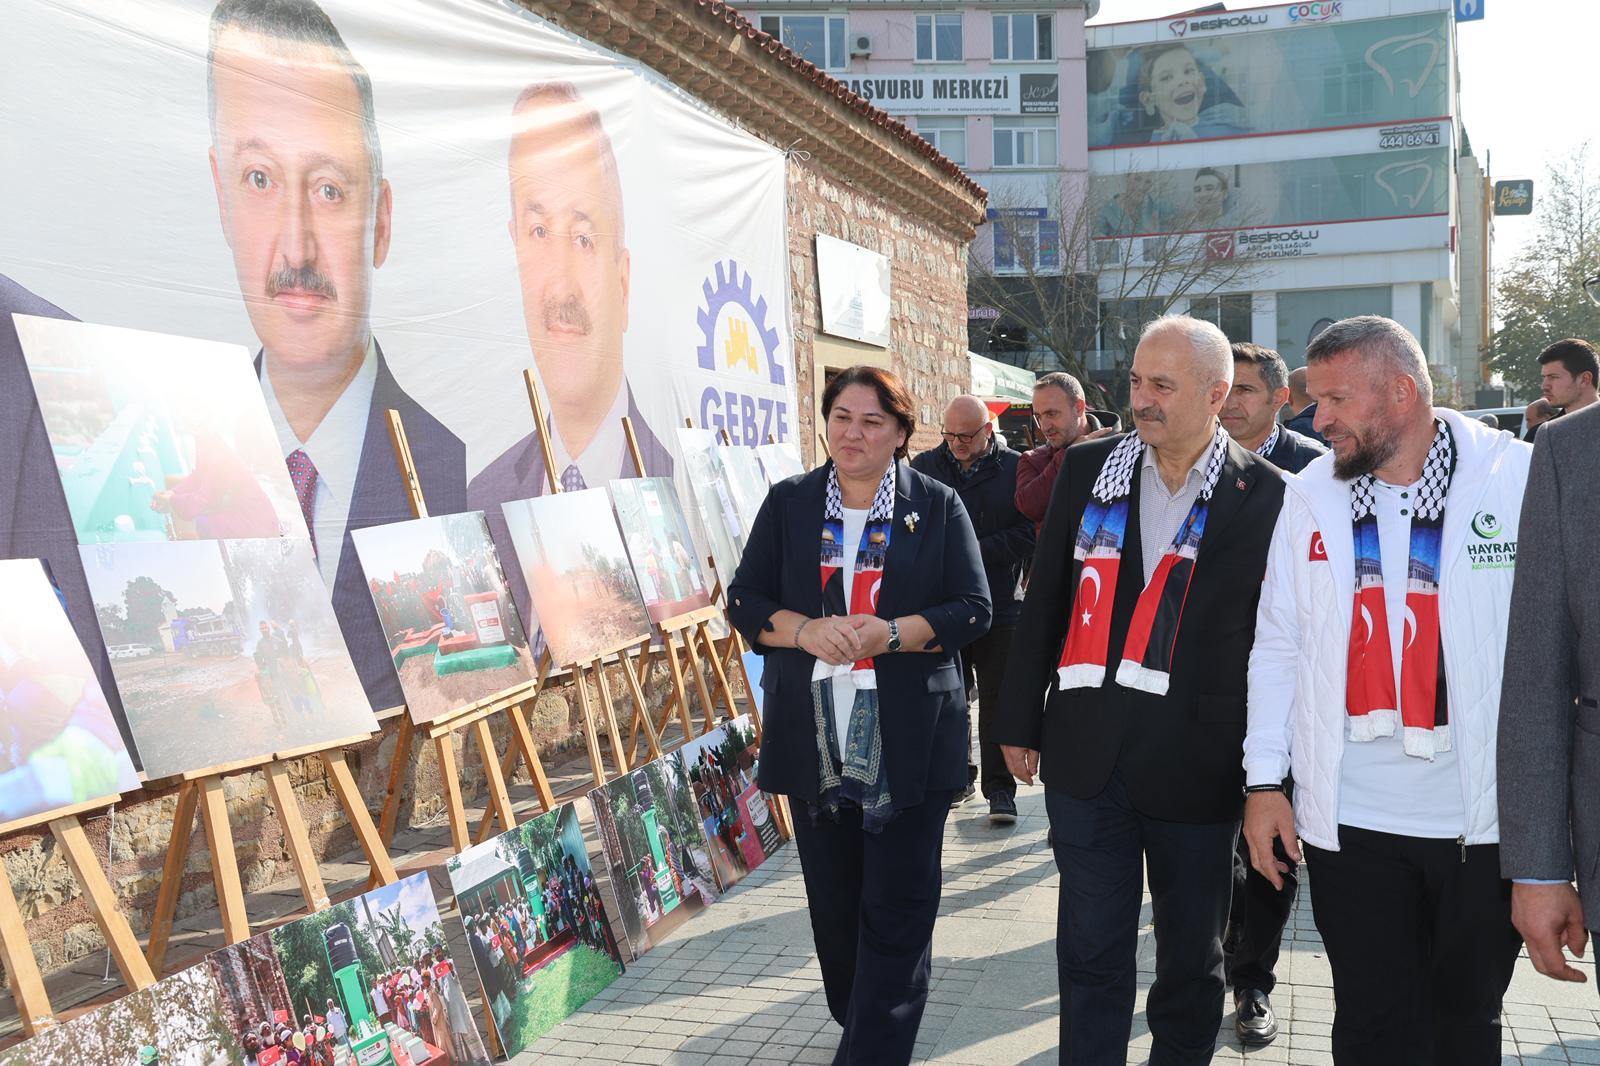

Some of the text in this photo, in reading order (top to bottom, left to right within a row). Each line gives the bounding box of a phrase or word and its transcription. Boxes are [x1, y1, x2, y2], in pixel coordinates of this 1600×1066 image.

[1288, 1, 1342, 22] ÇOCUK
[932, 76, 1009, 100] MERKEZİ
[1380, 131, 1440, 148] 444 86 41
[700, 386, 788, 450] GEBZE
[1467, 542, 1517, 554] HAYRAT
